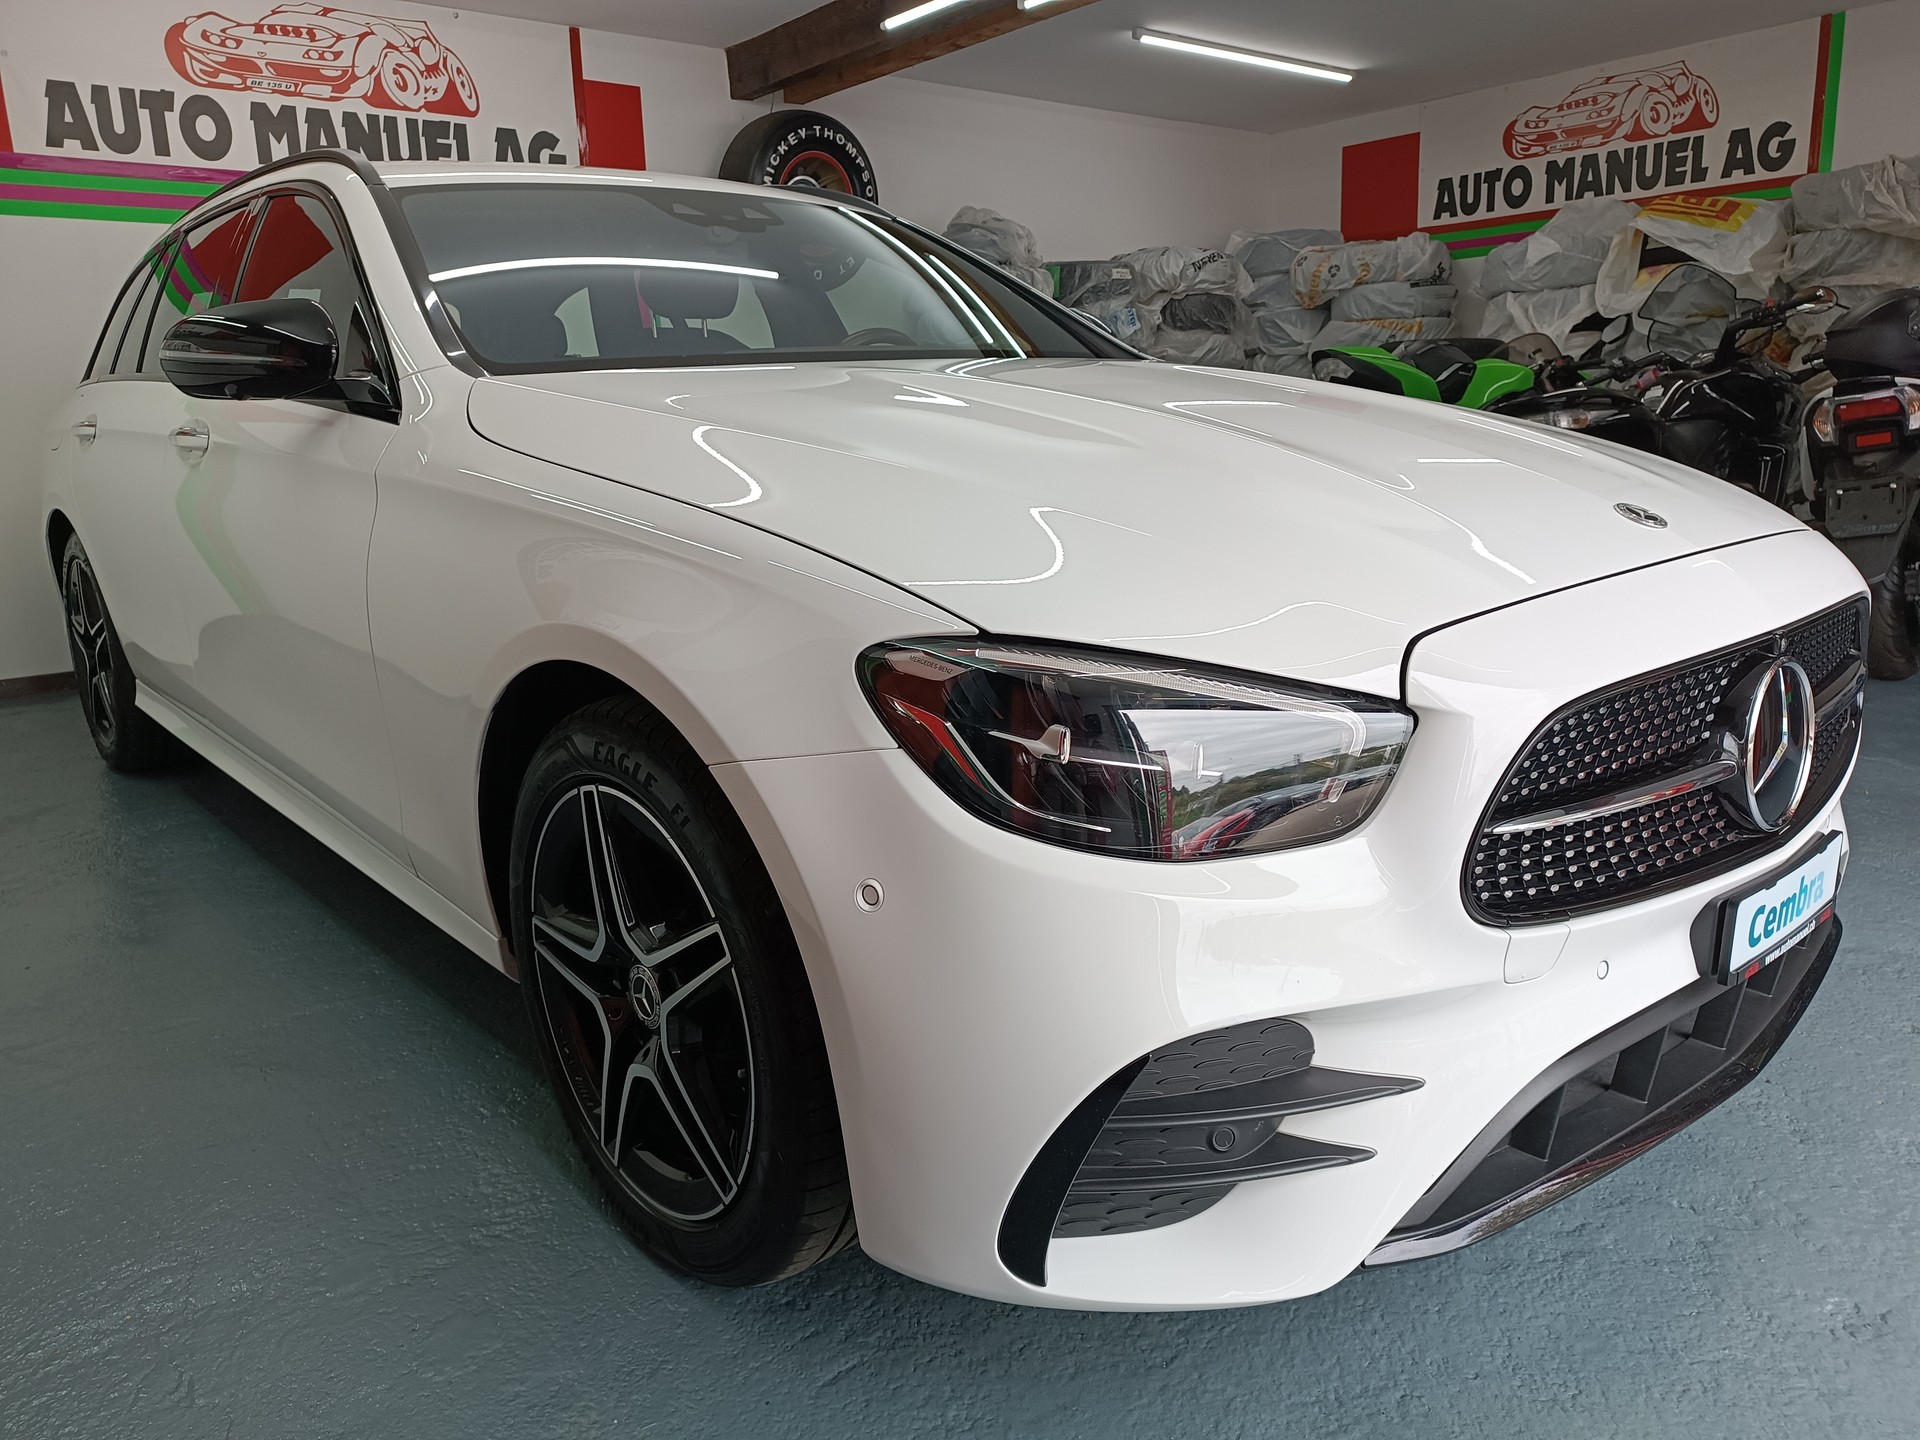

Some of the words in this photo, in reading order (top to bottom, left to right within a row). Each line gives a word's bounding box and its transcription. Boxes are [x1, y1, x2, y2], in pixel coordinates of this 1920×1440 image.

[44, 79, 233, 162] AUTO
[249, 101, 471, 164] MANUEL
[495, 127, 567, 165] AG
[812, 125, 874, 198] THOMPSO
[1433, 164, 1533, 220] AUTO
[1544, 135, 1709, 204] MANUEL
[1720, 120, 1797, 179] AG
[909, 654, 954, 674] MERCEDES-BENZ
[593, 740, 659, 794] EAGLE
[670, 802, 692, 829] F1
[1748, 870, 1825, 948] Cembra
